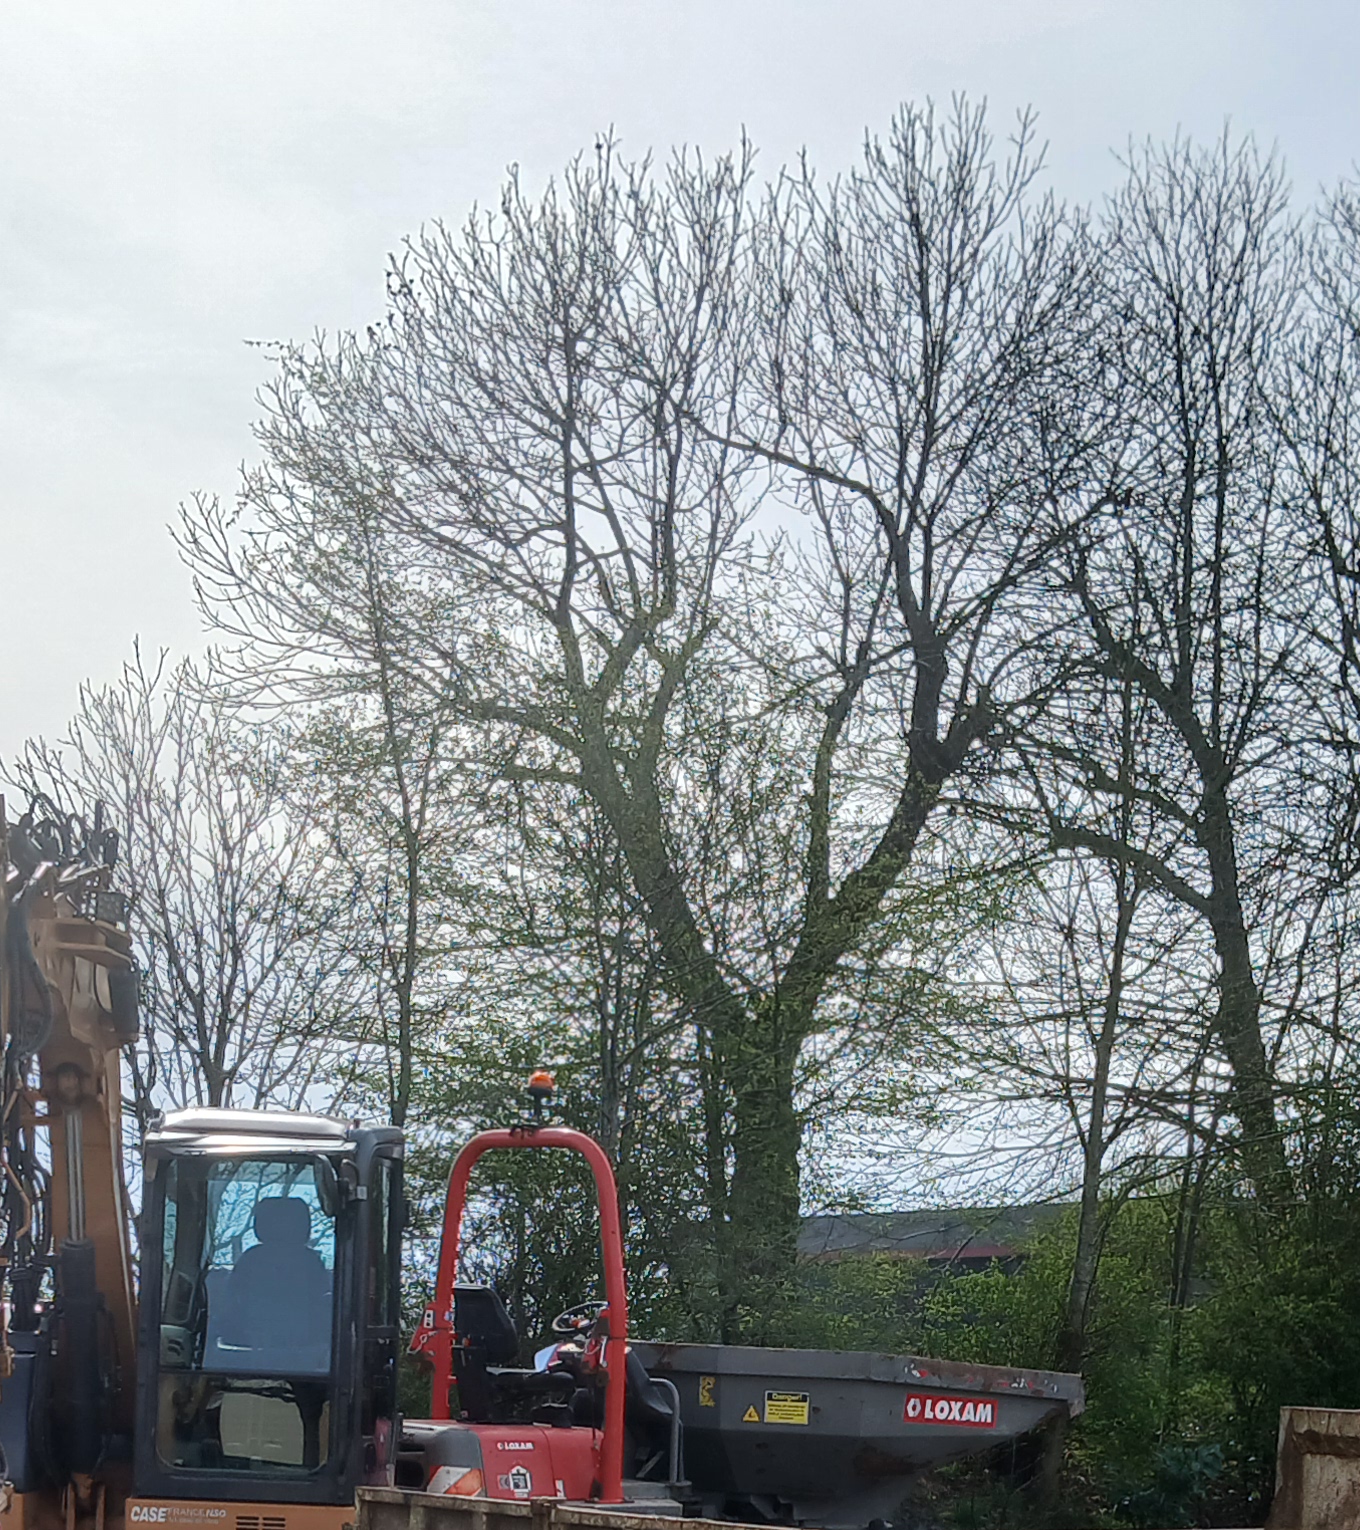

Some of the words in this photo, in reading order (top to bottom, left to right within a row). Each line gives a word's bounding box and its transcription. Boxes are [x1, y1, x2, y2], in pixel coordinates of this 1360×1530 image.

[924, 1399, 992, 1423] LOXAM
[504, 1442, 534, 1450] LOXAM
[130, 1506, 168, 1523] CASE
